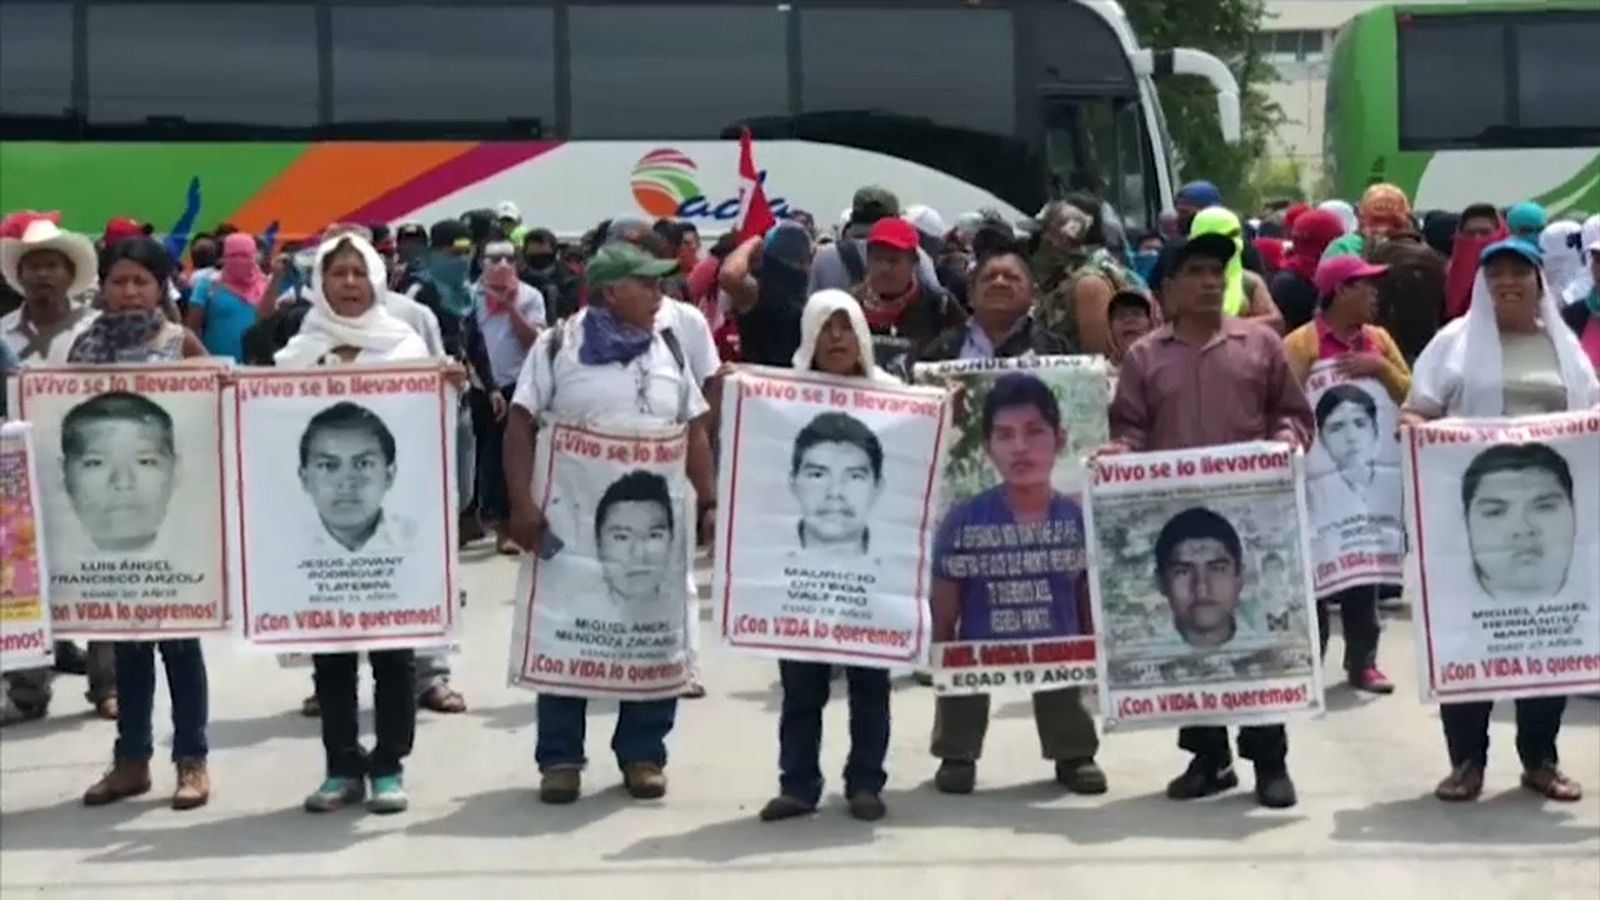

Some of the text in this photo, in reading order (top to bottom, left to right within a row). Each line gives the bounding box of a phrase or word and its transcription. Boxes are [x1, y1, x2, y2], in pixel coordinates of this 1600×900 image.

[26, 374, 214, 397] ¡Vivo se lo llevaron!
[241, 375, 436, 401] ¡Vivo se lo llevaron!
[801, 387, 823, 404] se
[830, 389, 847, 408] lo
[607, 444, 628, 462] se
[633, 441, 651, 462] lo
[1094, 452, 1289, 486] ¡Vivo se lo llevaron!
[81, 561, 116, 572] LUIS
[347, 556, 404, 567] JOVANY
[784, 567, 876, 584] MAURICIO
[75, 602, 113, 620] VIDA
[117, 602, 130, 619] lo
[134, 600, 217, 621] queremos!
[255, 605, 440, 633] ¡Con VIDA lo queremos!
[1472, 606, 1531, 619] MIGUEL
[734, 613, 911, 648] ¡Con VIDA lo queremos!
[531, 654, 563, 674] ¡Con
[570, 657, 606, 679] VIDA
[610, 662, 624, 679] lo
[952, 665, 1096, 687] EDAD 19 AÑOS
[1441, 660, 1476, 684] ¡Con
[1480, 658, 1522, 677] VIDA
[1527, 656, 1543, 675] lo
[1118, 684, 1307, 718] ¡Con VIDA lo queremos!
